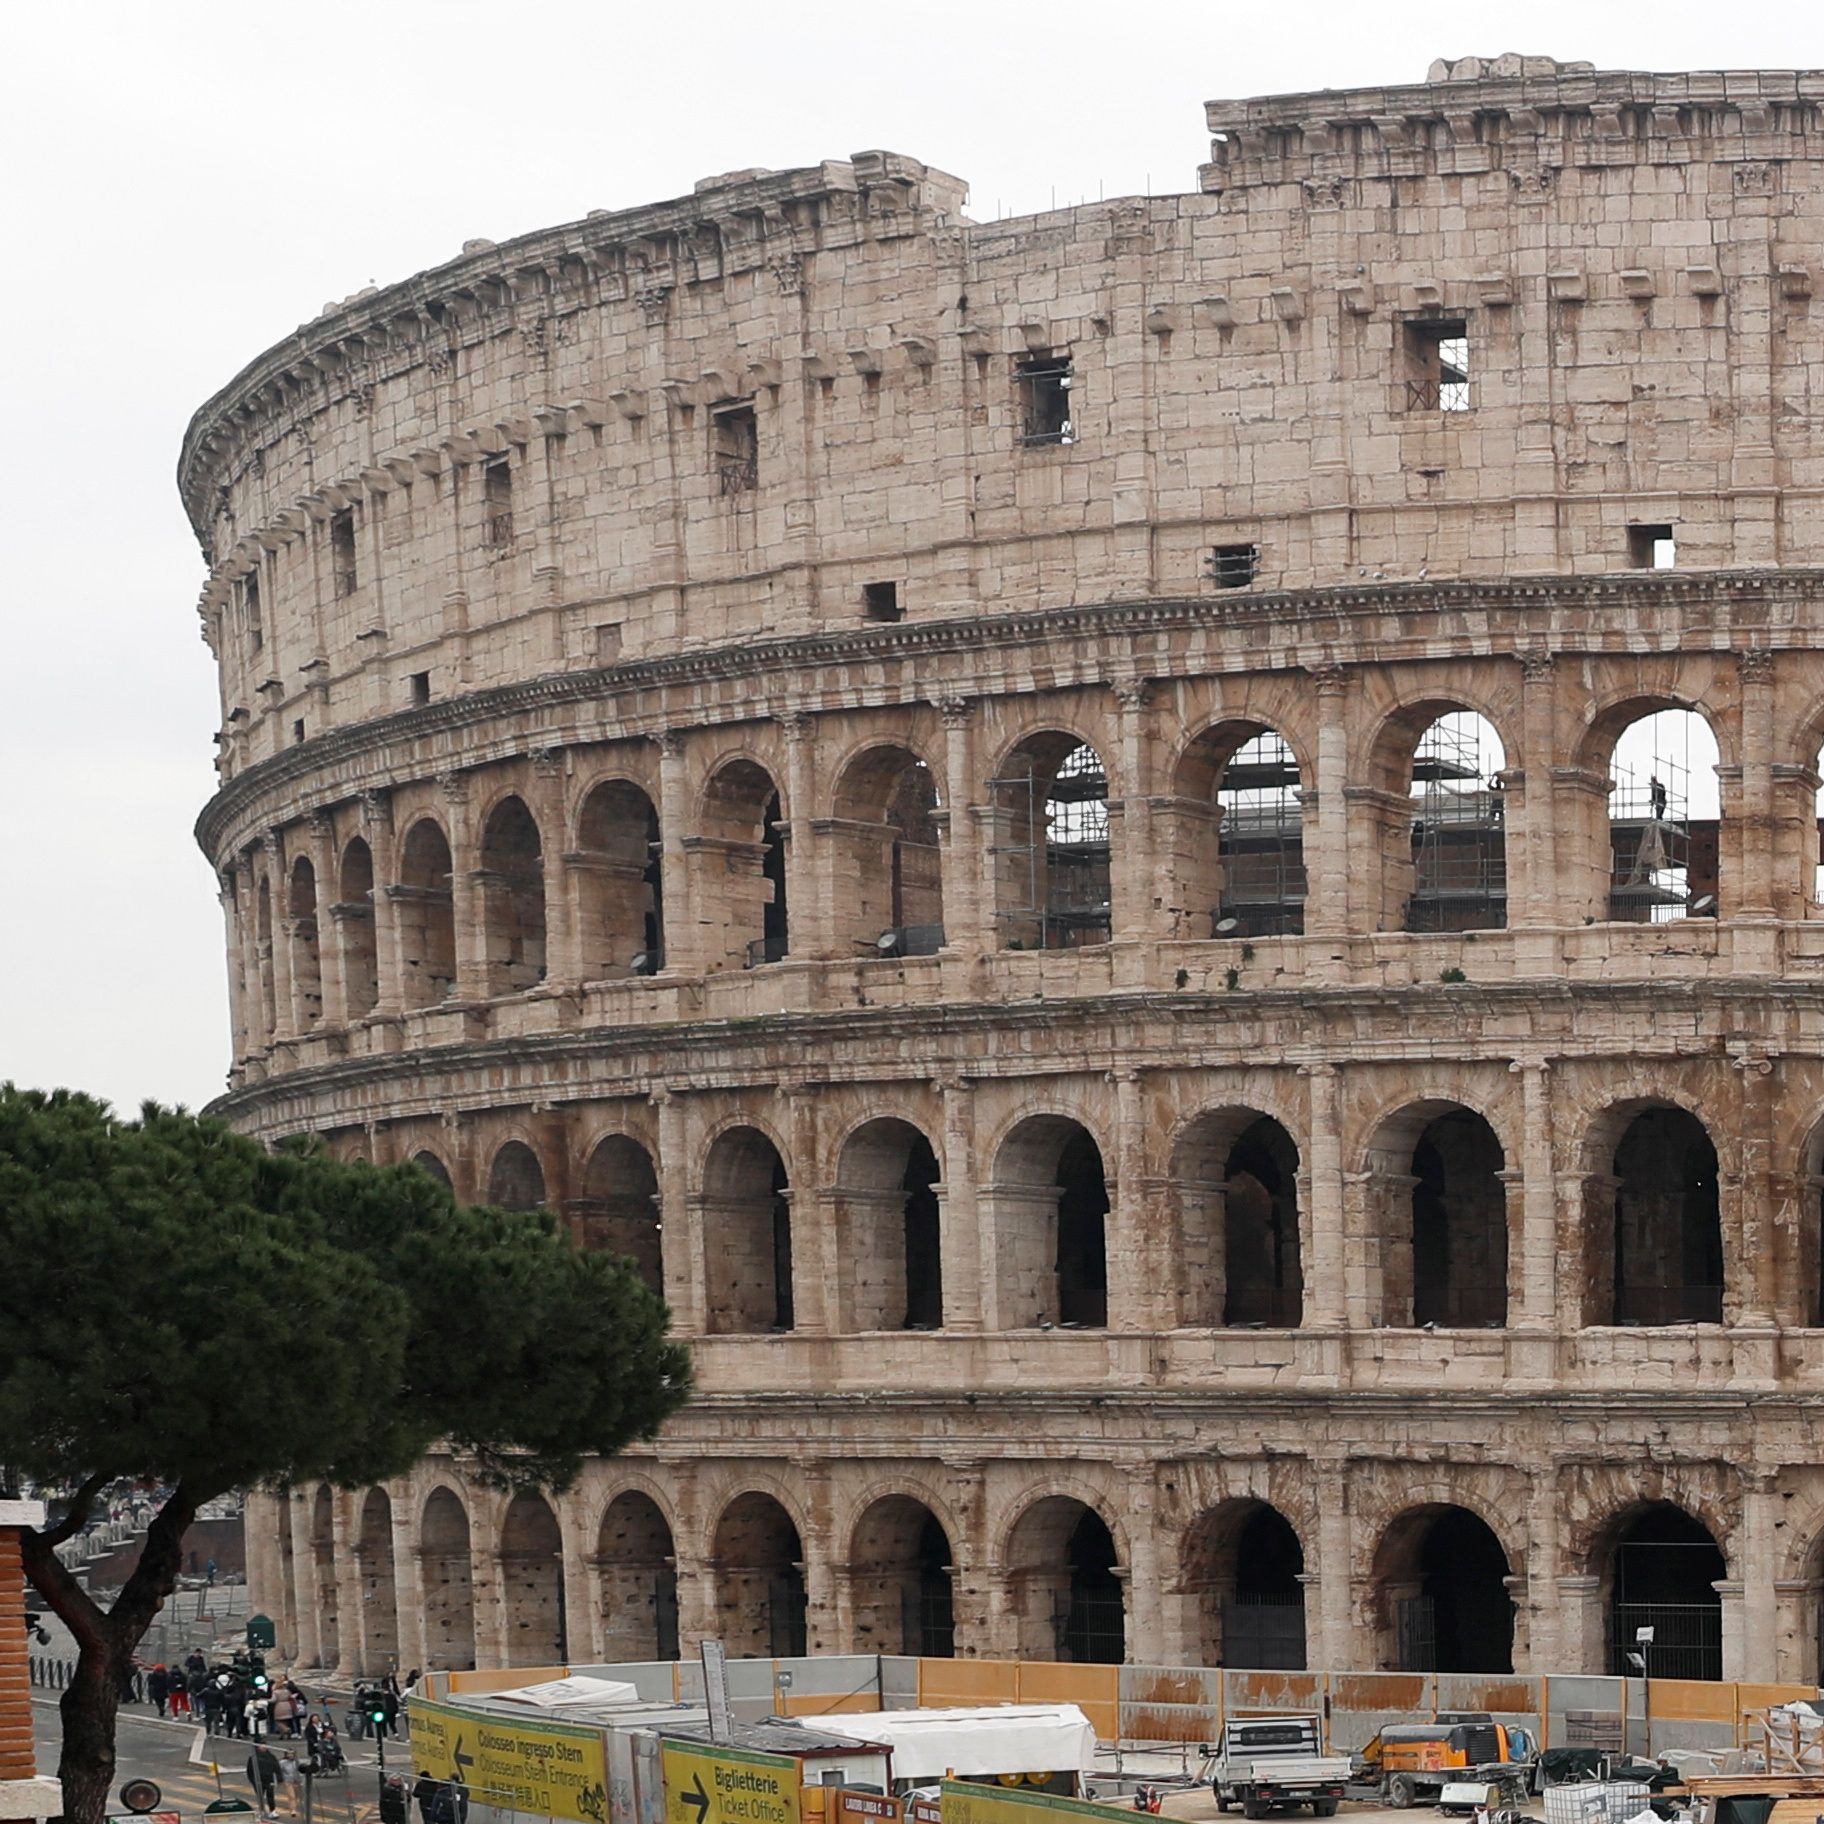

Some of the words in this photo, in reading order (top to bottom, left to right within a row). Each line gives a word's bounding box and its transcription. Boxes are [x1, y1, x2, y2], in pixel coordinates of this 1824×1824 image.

[478, 1730, 515, 1752] Colosseo
[517, 1736, 556, 1759] ingresso
[556, 1742, 583, 1763] Stern
[715, 1766, 778, 1795] Biglietterie
[716, 1792, 750, 1818] Ticket
[752, 1803, 785, 1823] Office
